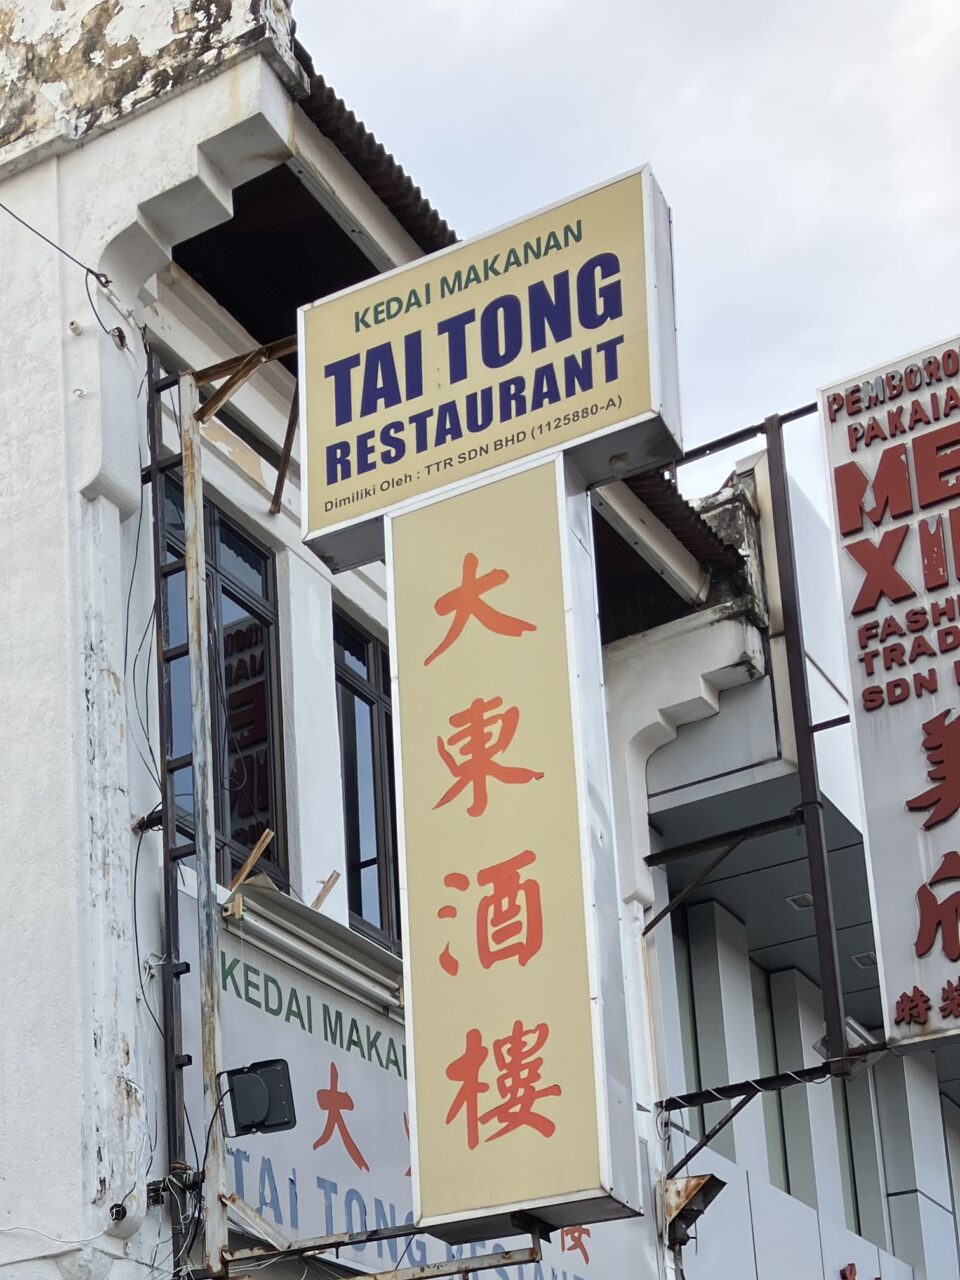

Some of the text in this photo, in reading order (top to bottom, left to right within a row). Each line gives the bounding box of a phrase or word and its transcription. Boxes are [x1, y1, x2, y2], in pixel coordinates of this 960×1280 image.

[353, 219, 583, 333] KEDAI MAKANAN
[324, 252, 624, 427] TAI TONG
[324, 484, 377, 513] Dimiliki
[380, 471, 413, 493] Oleh
[424, 456, 455, 477] TTR
[457, 444, 490, 466] SDN
[493, 430, 527, 452] BHD
[531, 394, 623, 440] (1125880-A)
[325, 334, 625, 486] RESTAURANT
[861, 667, 938, 712] SDN
[424, 551, 562, 1151] 大東酒樓
[220, 950, 313, 1034] KEDAI
[225, 1143, 299, 1232] TAI
[316, 1176, 428, 1265] TONG
